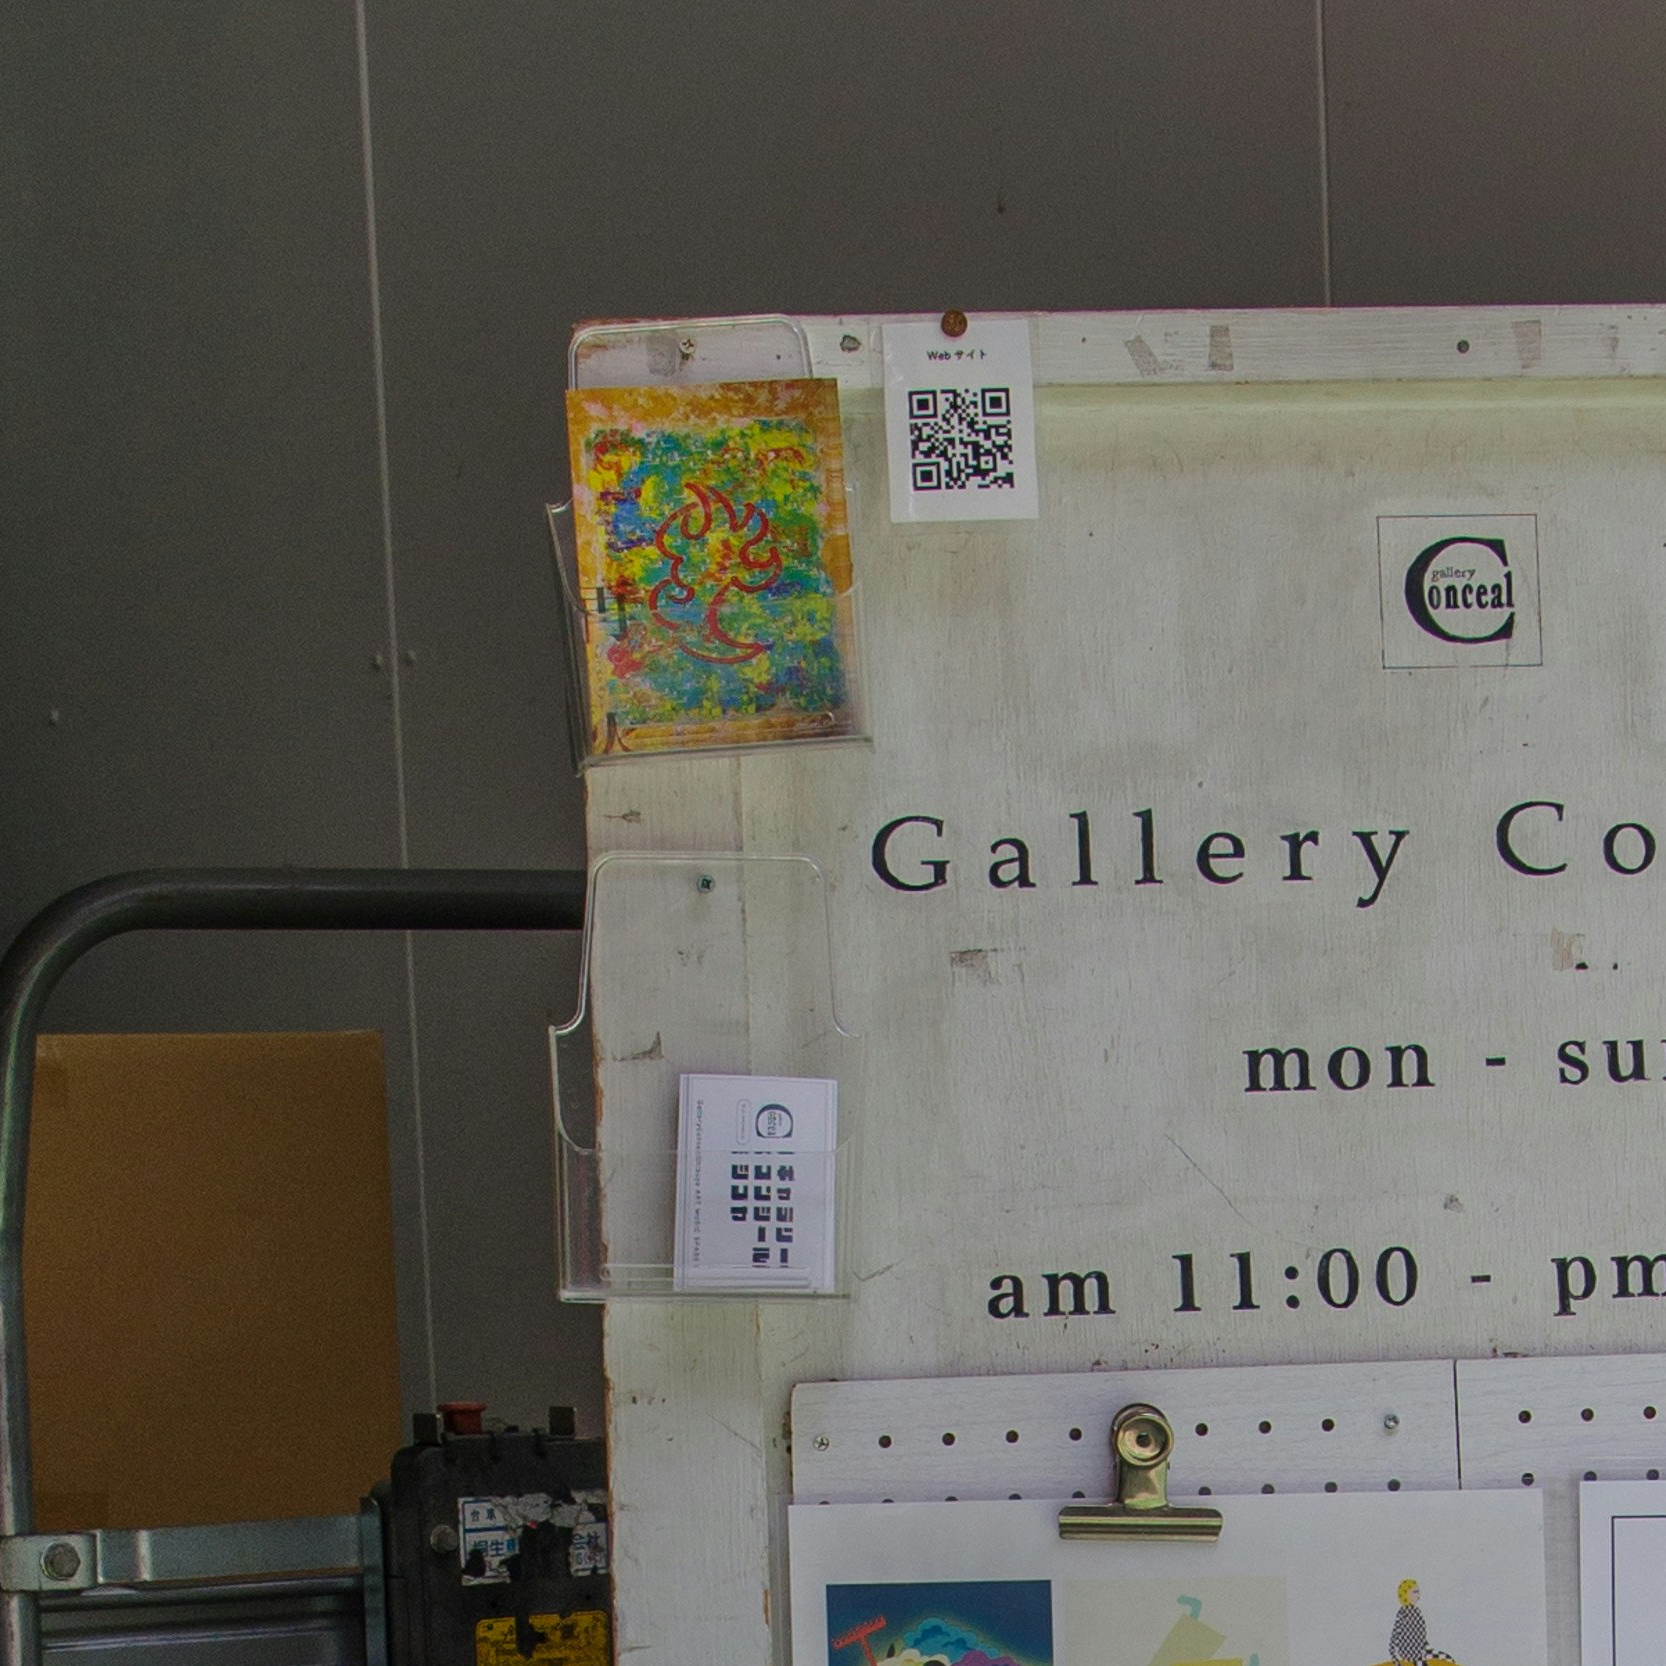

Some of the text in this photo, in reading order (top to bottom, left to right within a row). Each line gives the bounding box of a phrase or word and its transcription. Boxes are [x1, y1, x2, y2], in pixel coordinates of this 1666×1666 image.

[927, 349, 988, 361] Web サイト
[1431, 567, 1475, 582] gallery
[871, 810, 1412, 908] Gallery
[1244, 1044, 1435, 1093] mon
[985, 1270, 1115, 1320] am
[1173, 1247, 1420, 1311] 11:00
